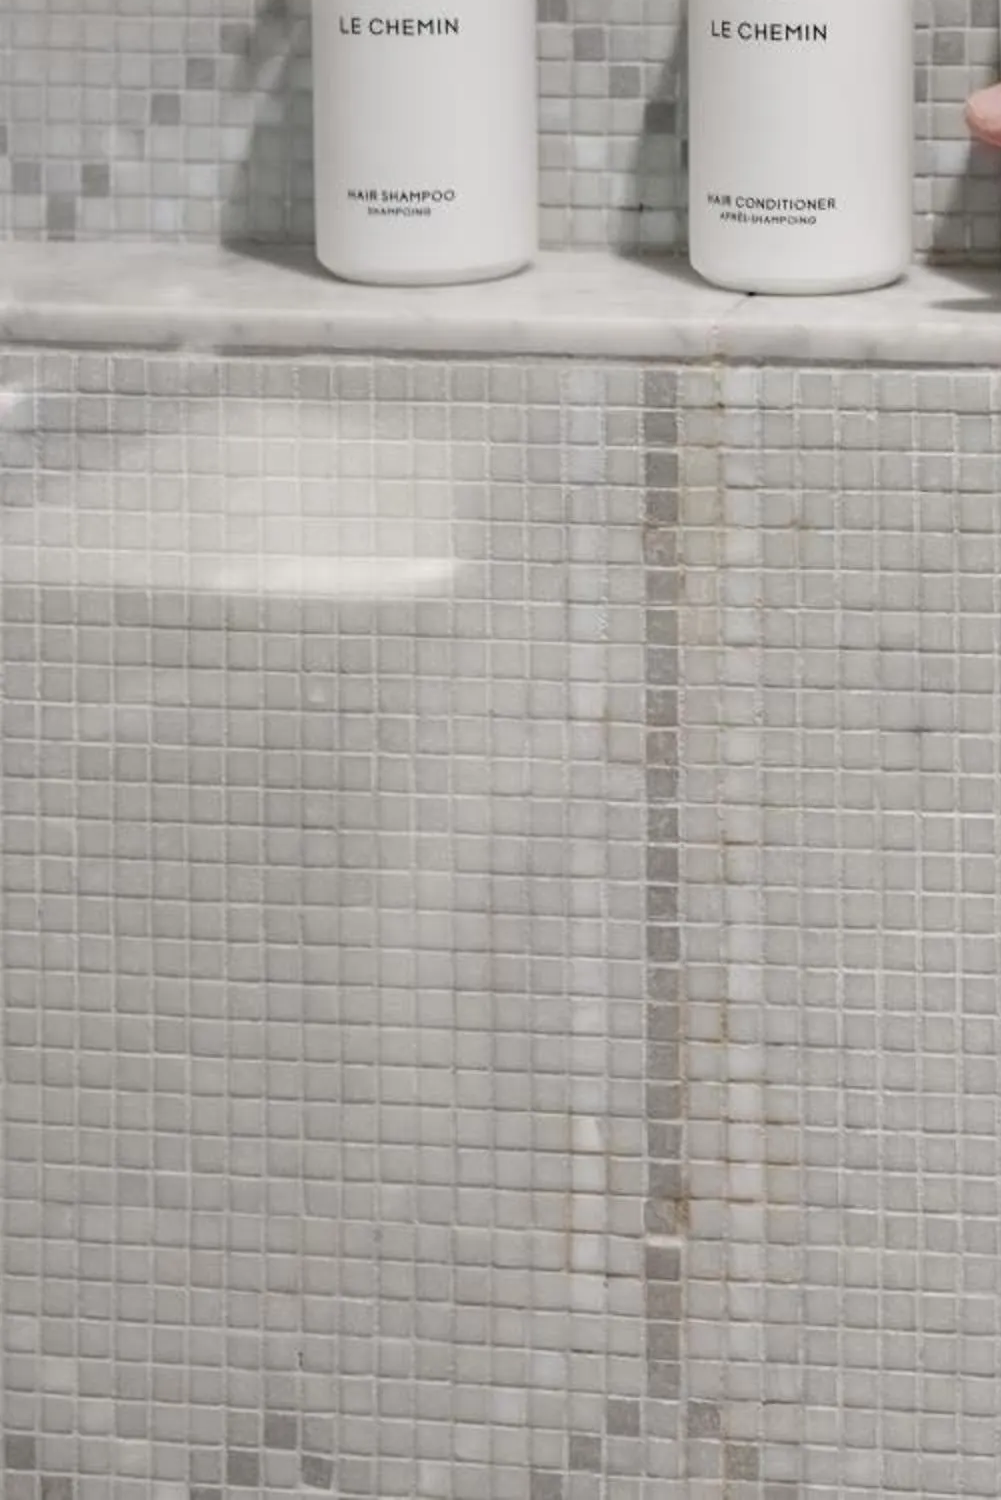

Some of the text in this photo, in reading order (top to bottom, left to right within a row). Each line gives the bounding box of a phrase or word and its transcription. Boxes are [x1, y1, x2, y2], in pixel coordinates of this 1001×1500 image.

[339, 15, 460, 36] LE CHEMIN
[710, 19, 828, 42] LE CHEMIN
[347, 189, 456, 202] HAIR SHAMPOO
[707, 194, 837, 211] HAIR CONDITIONER
